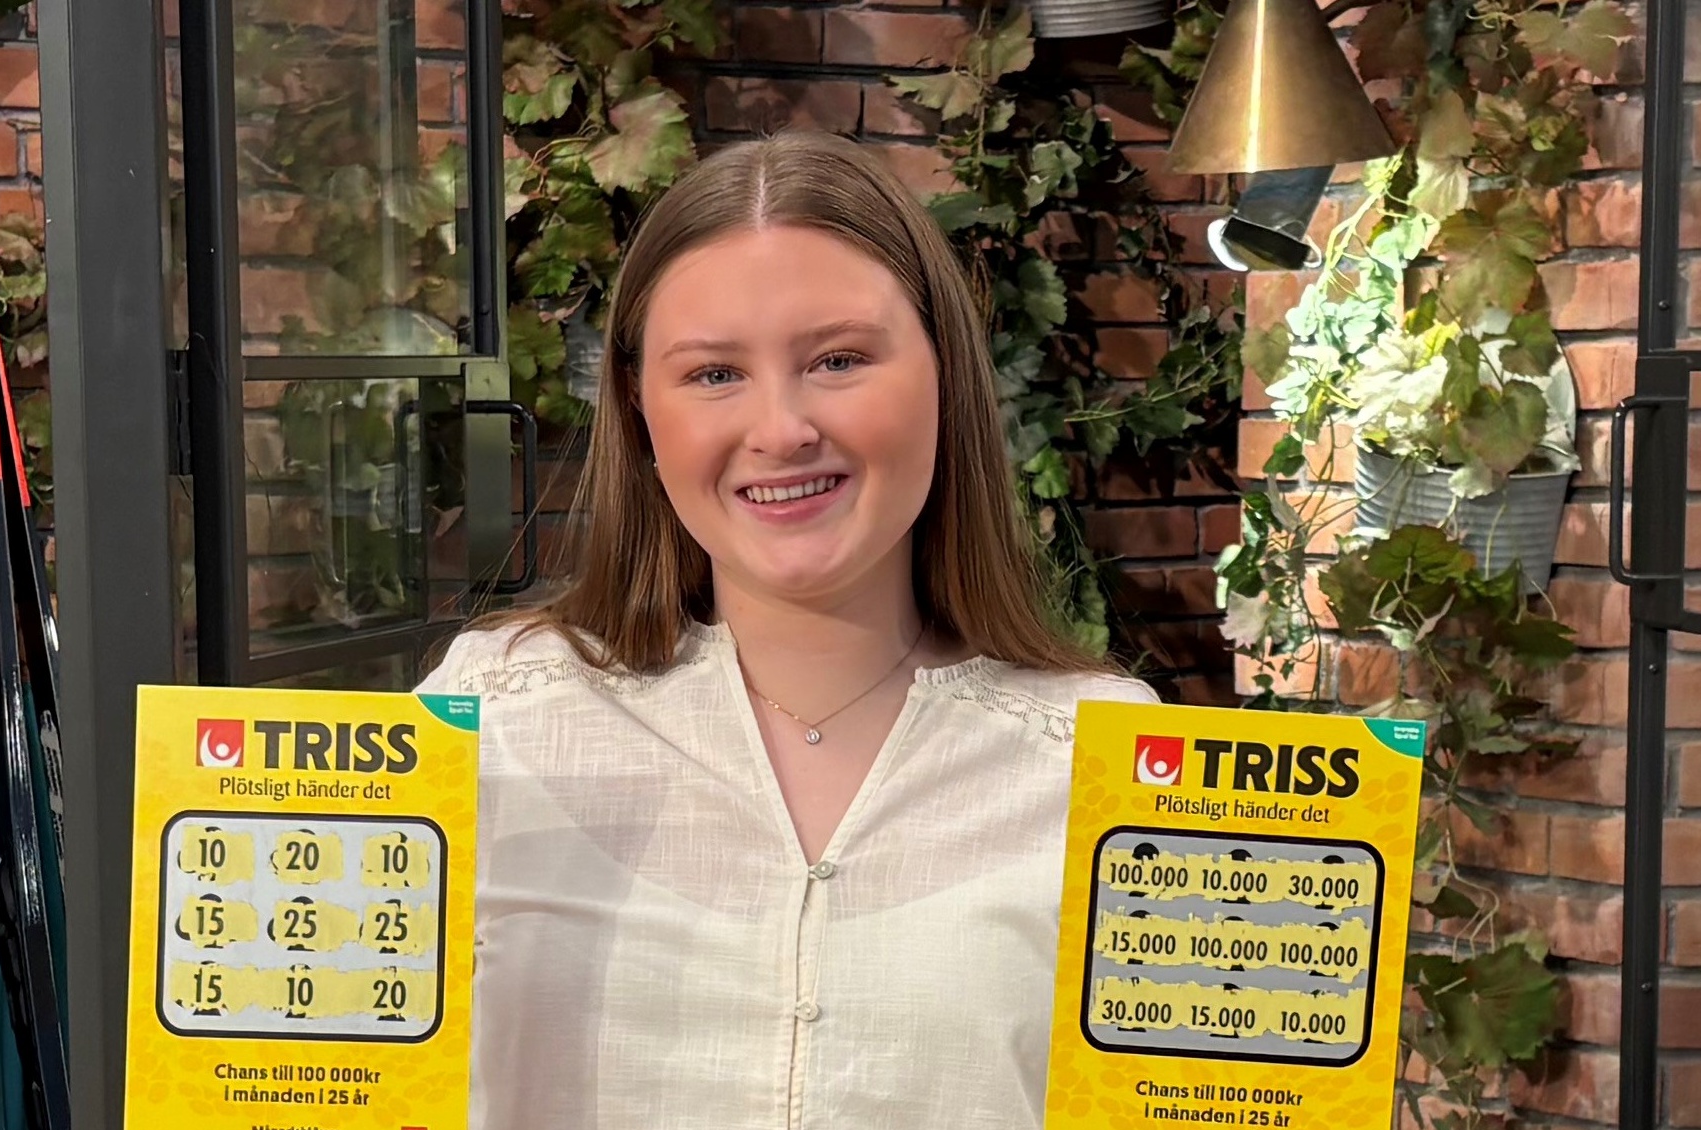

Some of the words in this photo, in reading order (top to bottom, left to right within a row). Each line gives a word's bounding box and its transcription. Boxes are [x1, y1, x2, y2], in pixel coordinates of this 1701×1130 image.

[254, 721, 418, 773] TRISS
[1194, 739, 1360, 798] TRISS
[220, 777, 290, 800] Plötsligt
[297, 779, 360, 798] händer
[363, 781, 391, 800] det
[1155, 794, 1227, 821] Plötsligt
[1234, 799, 1297, 821] händer
[1301, 804, 1330, 823] det
[199, 839, 226, 868] 10
[286, 842, 319, 870] 20
[382, 844, 408, 873] 10
[1110, 862, 1188, 887] 100.000
[1202, 869, 1267, 893] 10.000
[1288, 875, 1359, 899] 30.000
[196, 906, 224, 935] 15
[284, 909, 317, 938] 25
[375, 912, 407, 941] 25
[1112, 931, 1176, 955] 15.000
[1191, 936, 1267, 961] 100.000
[1280, 942, 1358, 967] 100.000
[194, 974, 222, 1003] 15
[287, 977, 313, 1007] 10
[373, 980, 406, 1009] 20
[1102, 1000, 1172, 1023] 30.000
[1191, 1005, 1255, 1029] 15.000
[1281, 1011, 1346, 1035] 10.000
[215, 1063, 267, 1080] Chans
[272, 1065, 293, 1081] till
[298, 1066, 325, 1082] 100
[331, 1068, 381, 1083] 000kr
[224, 1085, 229, 1101] i
[234, 1085, 314, 1104] månaden
[319, 1088, 324, 1104] i
[328, 1090, 349, 1105] 25
[353, 1088, 370, 1105] år
[1136, 1080, 1188, 1098] Chans
[1194, 1084, 1215, 1100] till
[1220, 1086, 1247, 1102] 100
[1252, 1088, 1302, 1106] 000kr
[1145, 1103, 1149, 1118] i
[1154, 1103, 1235, 1124] månaden
[1240, 1110, 1244, 1124] i
[1248, 1110, 1269, 1126] 25
[1274, 1111, 1290, 1127] år
